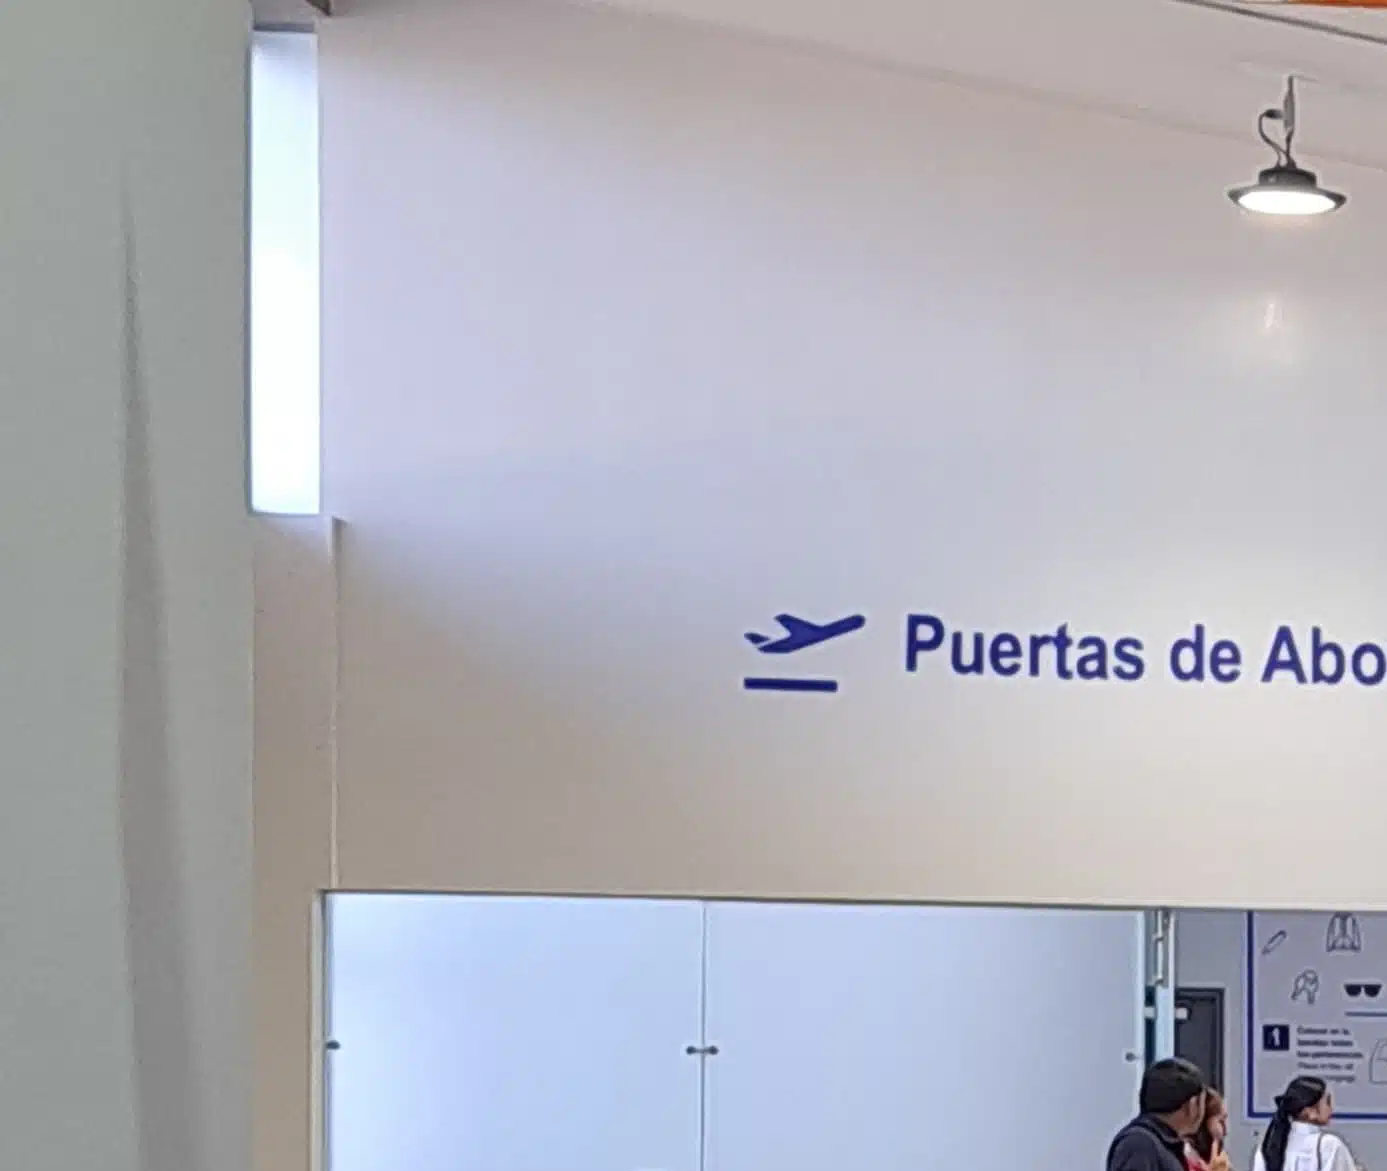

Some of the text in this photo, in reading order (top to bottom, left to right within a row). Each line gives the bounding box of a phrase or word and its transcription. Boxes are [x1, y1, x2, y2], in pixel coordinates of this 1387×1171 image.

[906, 614, 1144, 681] Puertas
[1170, 624, 1241, 684] de
[1272, 1027, 1280, 1046] 1
